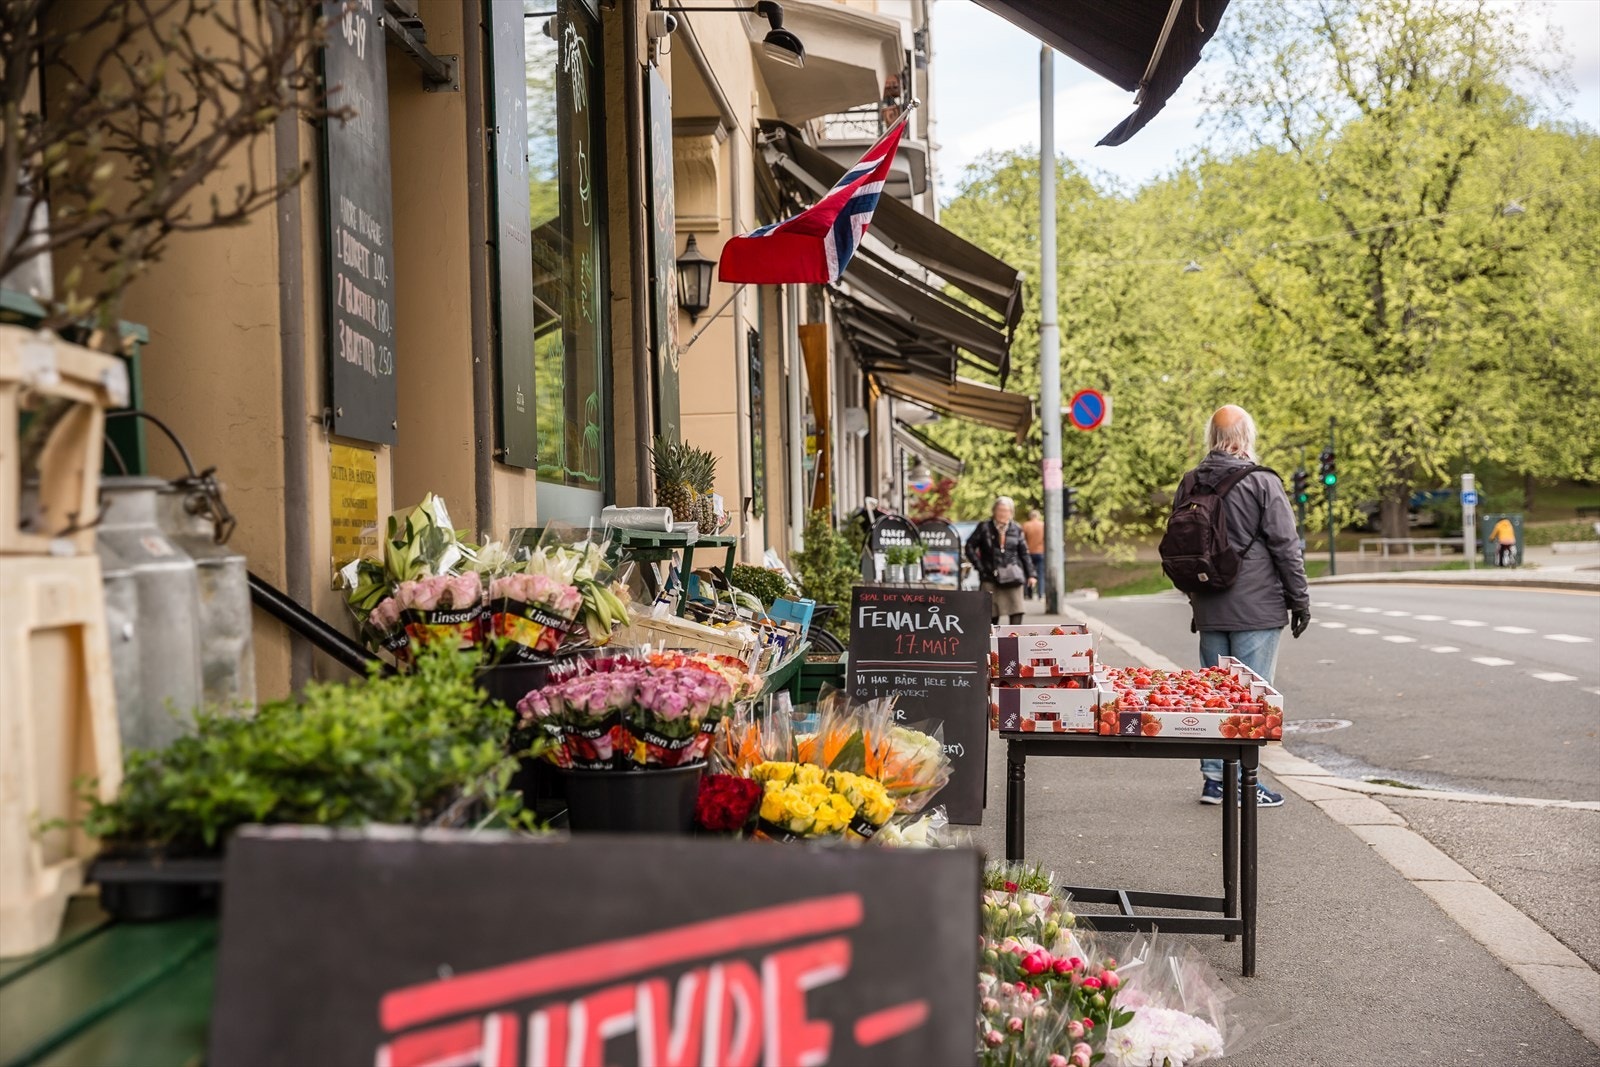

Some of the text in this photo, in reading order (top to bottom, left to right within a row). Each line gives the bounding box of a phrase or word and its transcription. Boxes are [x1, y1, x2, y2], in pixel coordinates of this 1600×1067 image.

[337, 273, 344, 308] 2
[339, 319, 345, 357] 3
[883, 594, 898, 602] DET
[859, 606, 964, 634] FENALÅR
[894, 634, 919, 655] 17.
[857, 674, 972, 688] VI HAR BÅDE HELE LÅR
[942, 743, 965, 757] EKT)
